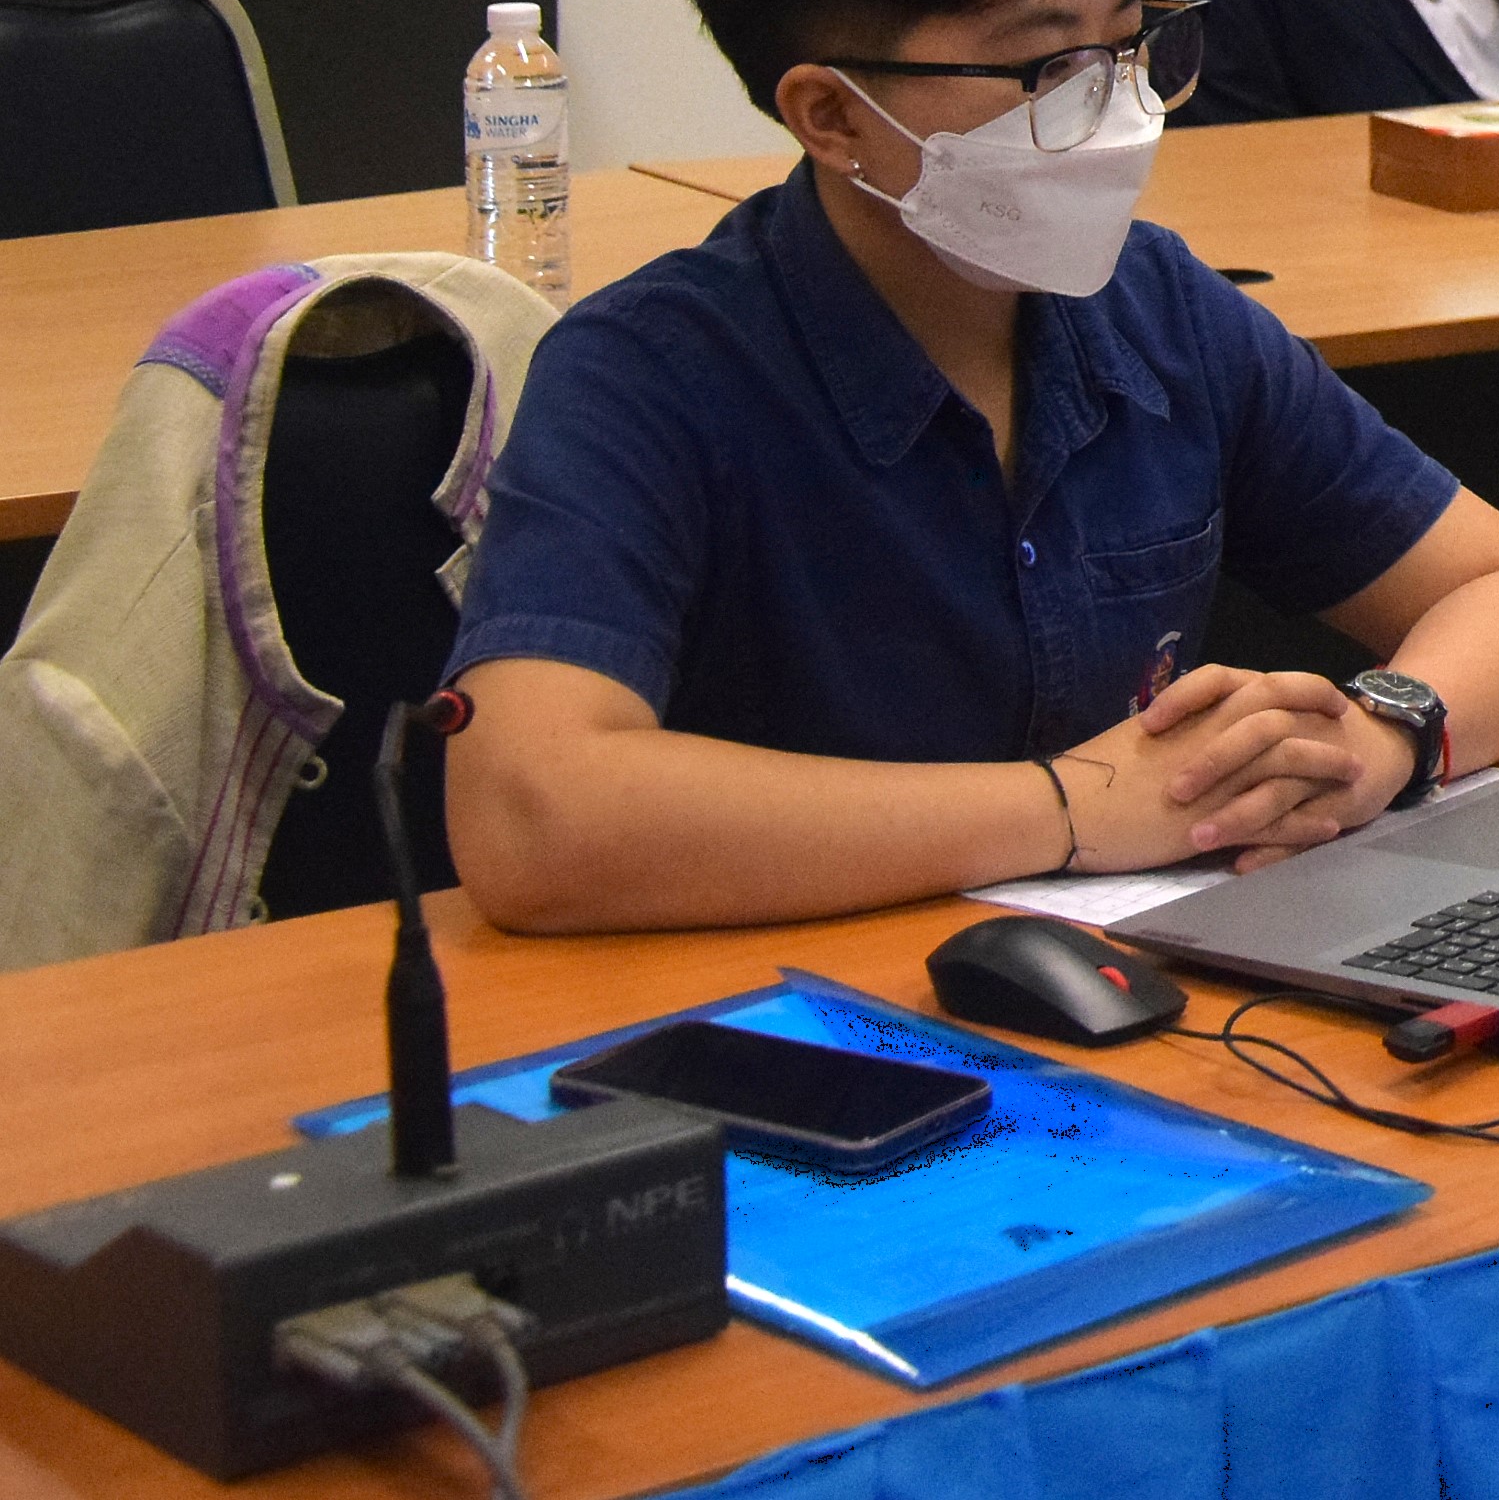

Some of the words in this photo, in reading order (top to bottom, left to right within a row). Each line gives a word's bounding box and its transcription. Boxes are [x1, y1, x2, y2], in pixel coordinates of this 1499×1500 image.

[484, 114, 540, 126] SINGHA
[485, 127, 528, 138] WATER
[605, 1174, 707, 1231] NPE
